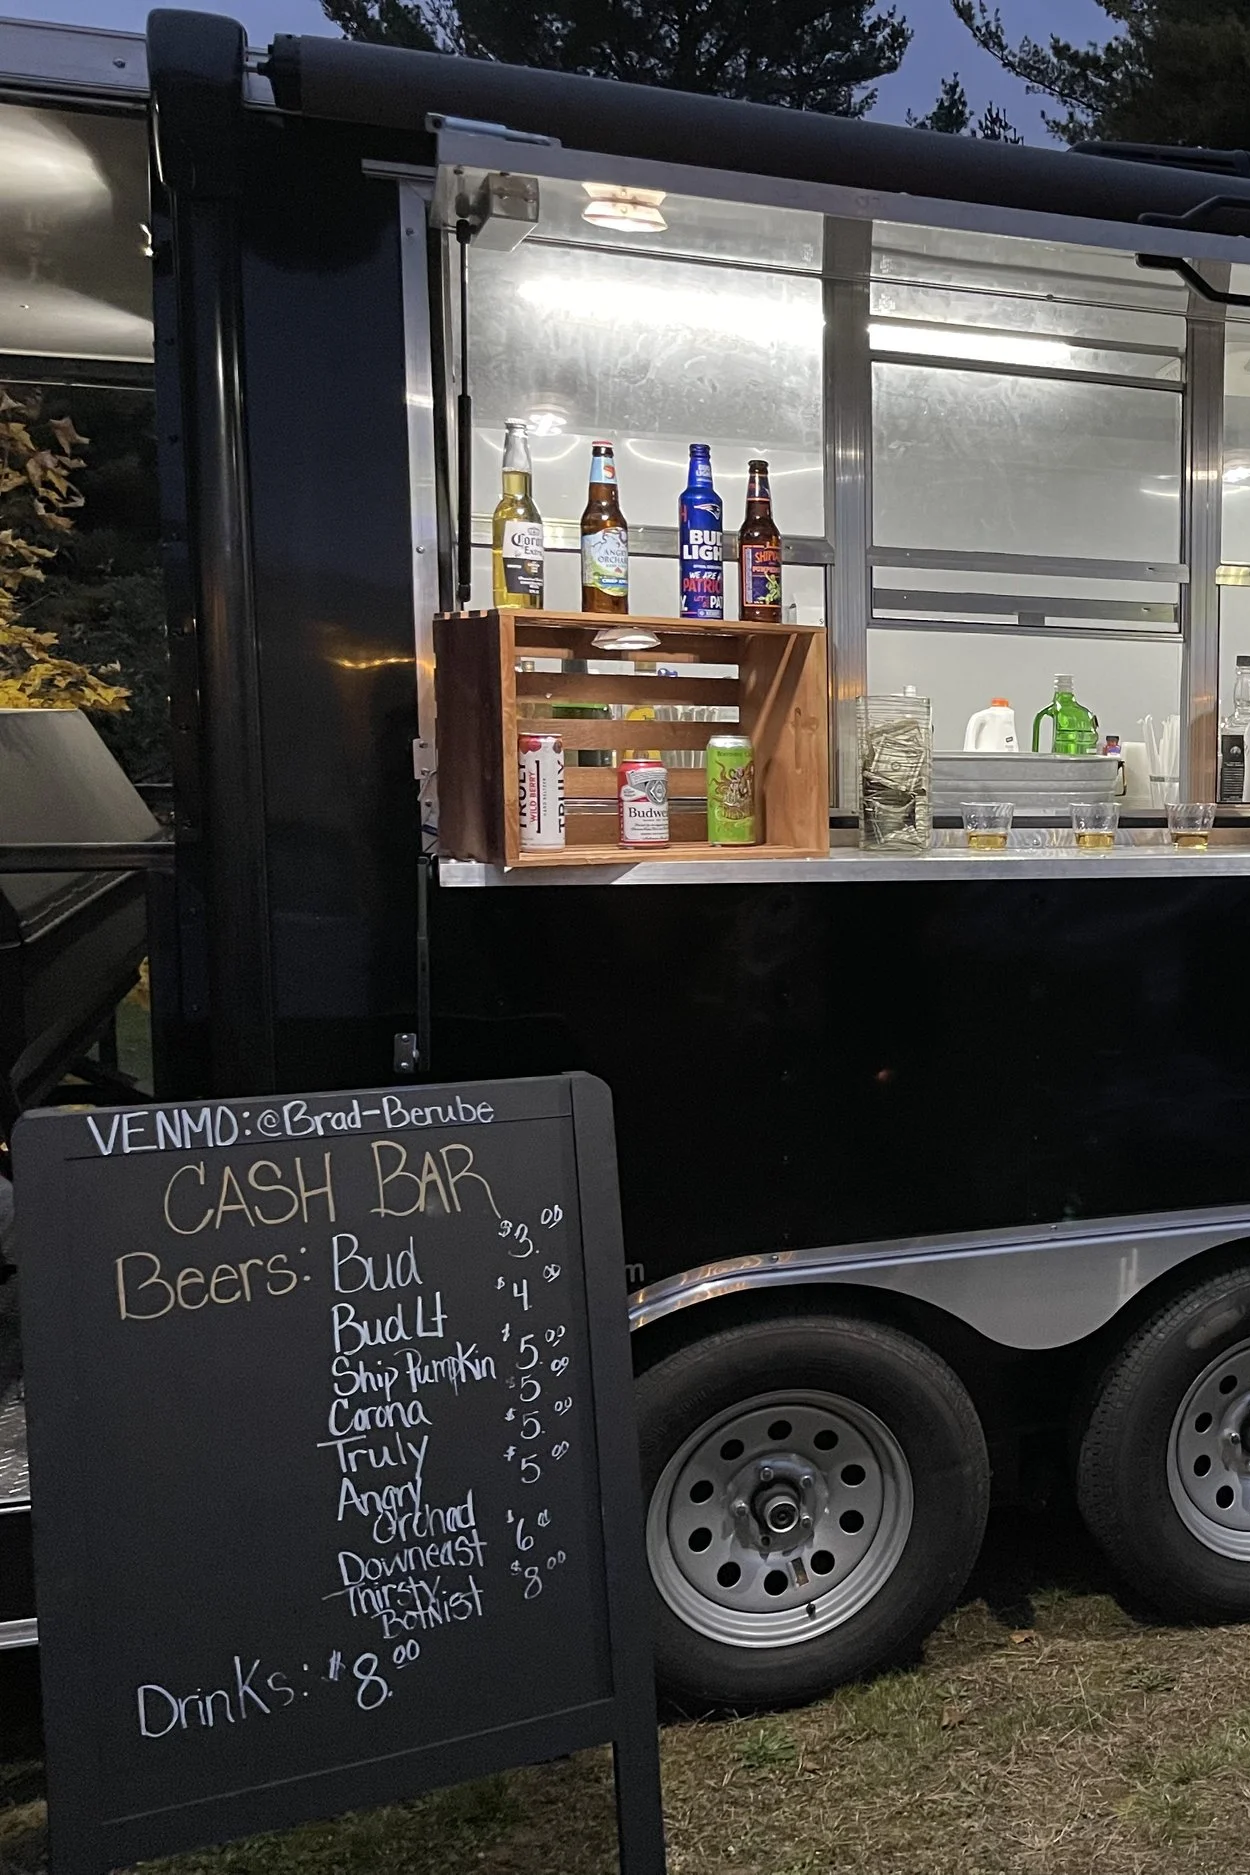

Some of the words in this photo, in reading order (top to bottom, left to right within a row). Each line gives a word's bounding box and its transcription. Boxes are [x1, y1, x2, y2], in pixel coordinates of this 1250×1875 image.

[529, 772, 537, 798] BERRY
[530, 800, 538, 823] WILD
[163, 1151, 336, 1235] CASH
[369, 1140, 501, 1219] BAR
[115, 1247, 311, 1321] Beers:
[332, 1233, 424, 1295] Bud
[331, 1302, 413, 1356] Bud
[332, 1355, 399, 1402] Ship
[328, 1398, 433, 1437] Corona
[317, 1431, 429, 1480] Truly
[337, 1477, 422, 1524] Angry
[338, 1529, 488, 1587] Downeast
[321, 1576, 441, 1617] Thirsty
